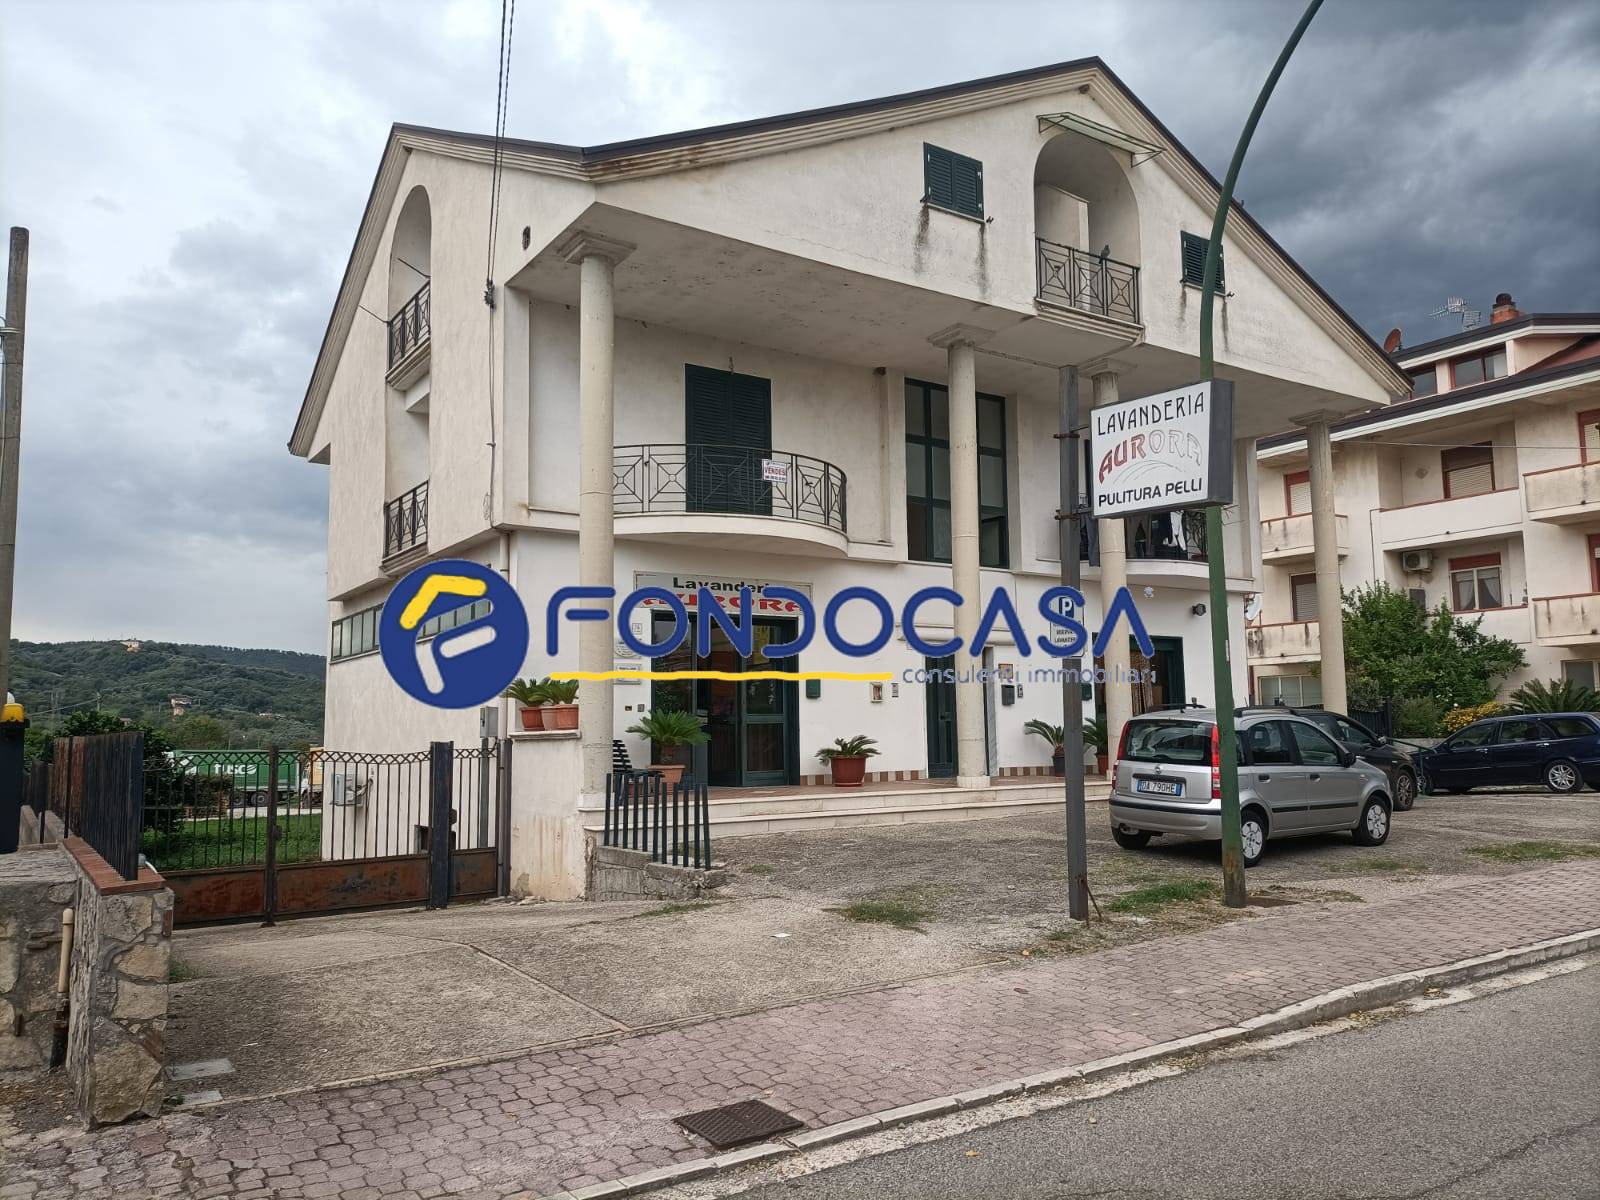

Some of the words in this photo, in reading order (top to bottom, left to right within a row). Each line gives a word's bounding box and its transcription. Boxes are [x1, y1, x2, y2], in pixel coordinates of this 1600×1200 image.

[1098, 391, 1204, 436] LAVANDERIA
[1099, 429, 1203, 485] AURORA
[1099, 485, 1161, 507] PULITURA
[1166, 478, 1202, 497] PELLI
